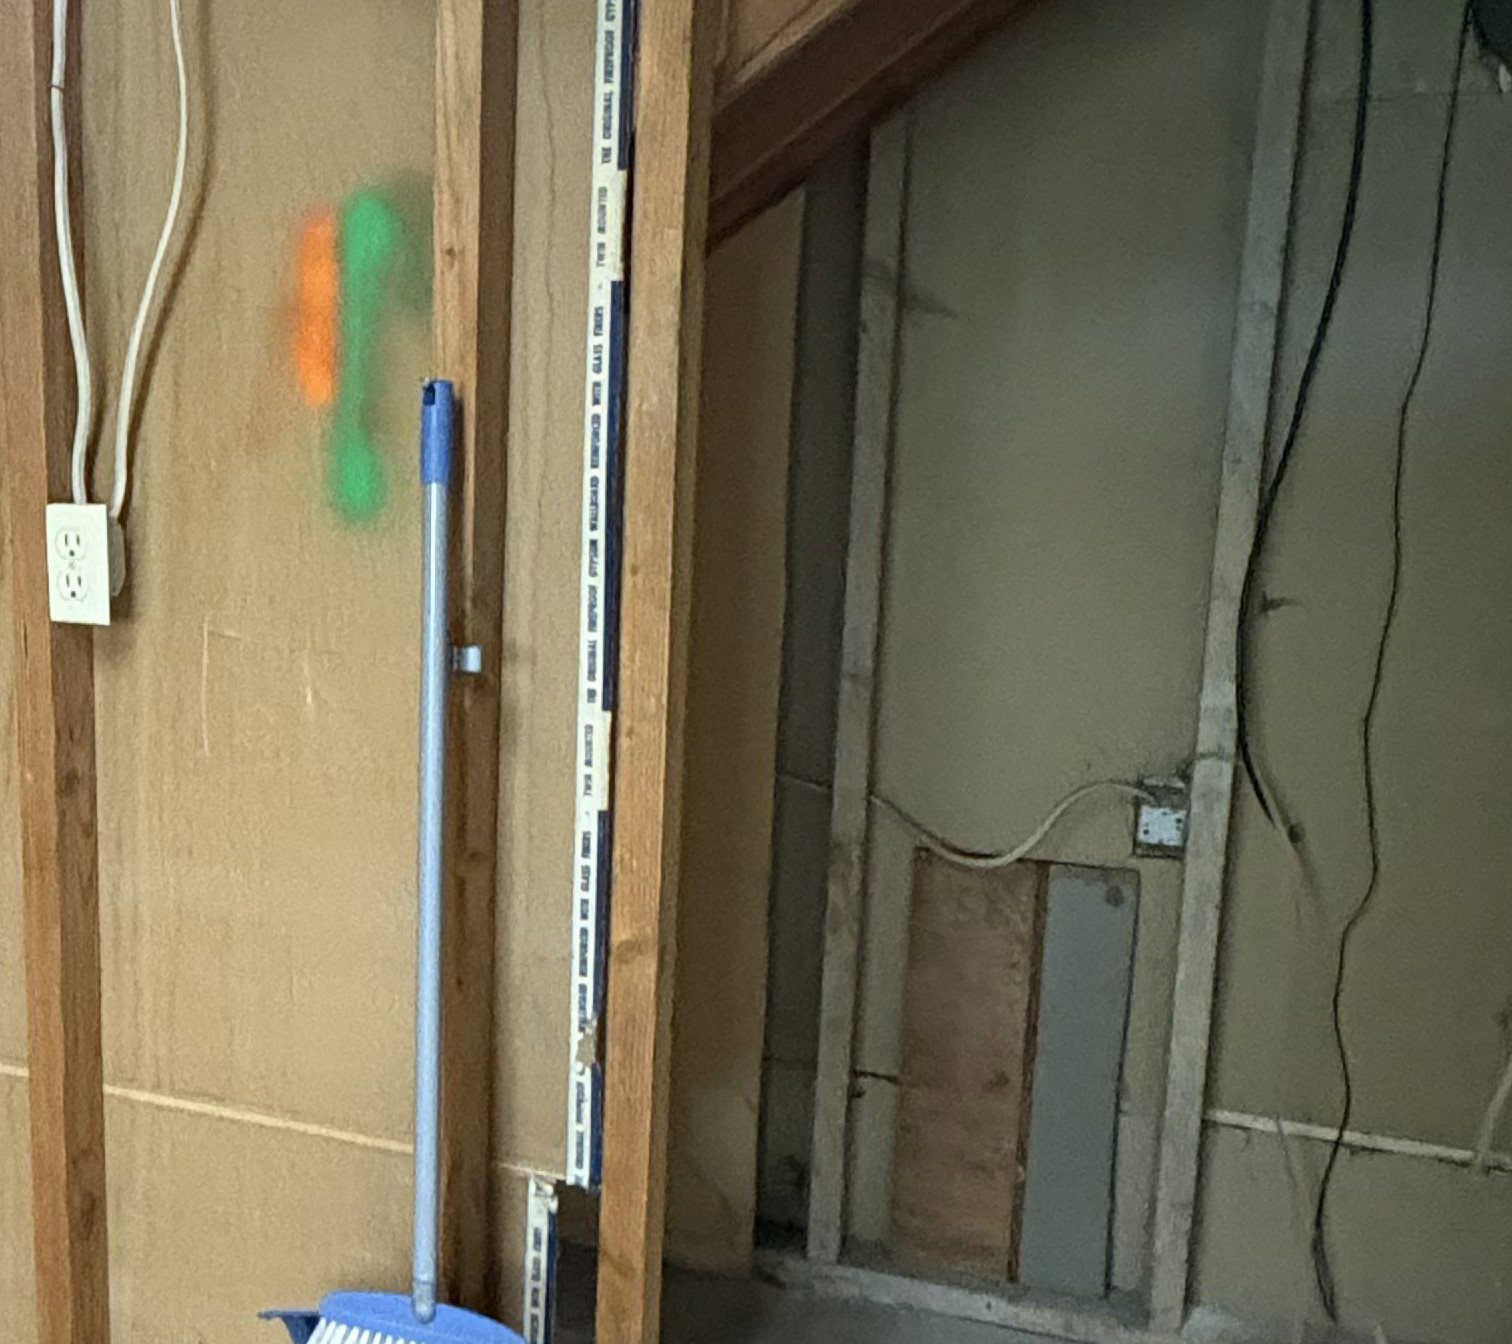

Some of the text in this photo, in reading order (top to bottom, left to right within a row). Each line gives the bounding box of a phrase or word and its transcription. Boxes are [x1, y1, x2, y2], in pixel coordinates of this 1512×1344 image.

[604, 30, 615, 83] FIREPROOF
[603, 92, 613, 139] ORIGINAL
[602, 147, 612, 163] THE
[597, 242, 606, 267] TWIN
[593, 345, 603, 374] GLASS
[592, 381, 602, 405] WITH
[591, 414, 601, 469] REINFORCED
[590, 476, 599, 531] WALLBOARD
[589, 539, 599, 577] GYPSUM
[588, 585, 598, 632] FIREPROOF
[588, 641, 596, 682] ORIGINAL
[581, 865, 590, 891] GLASS
[581, 899, 589, 920] WITH
[579, 927, 588, 977] REINFORCED
